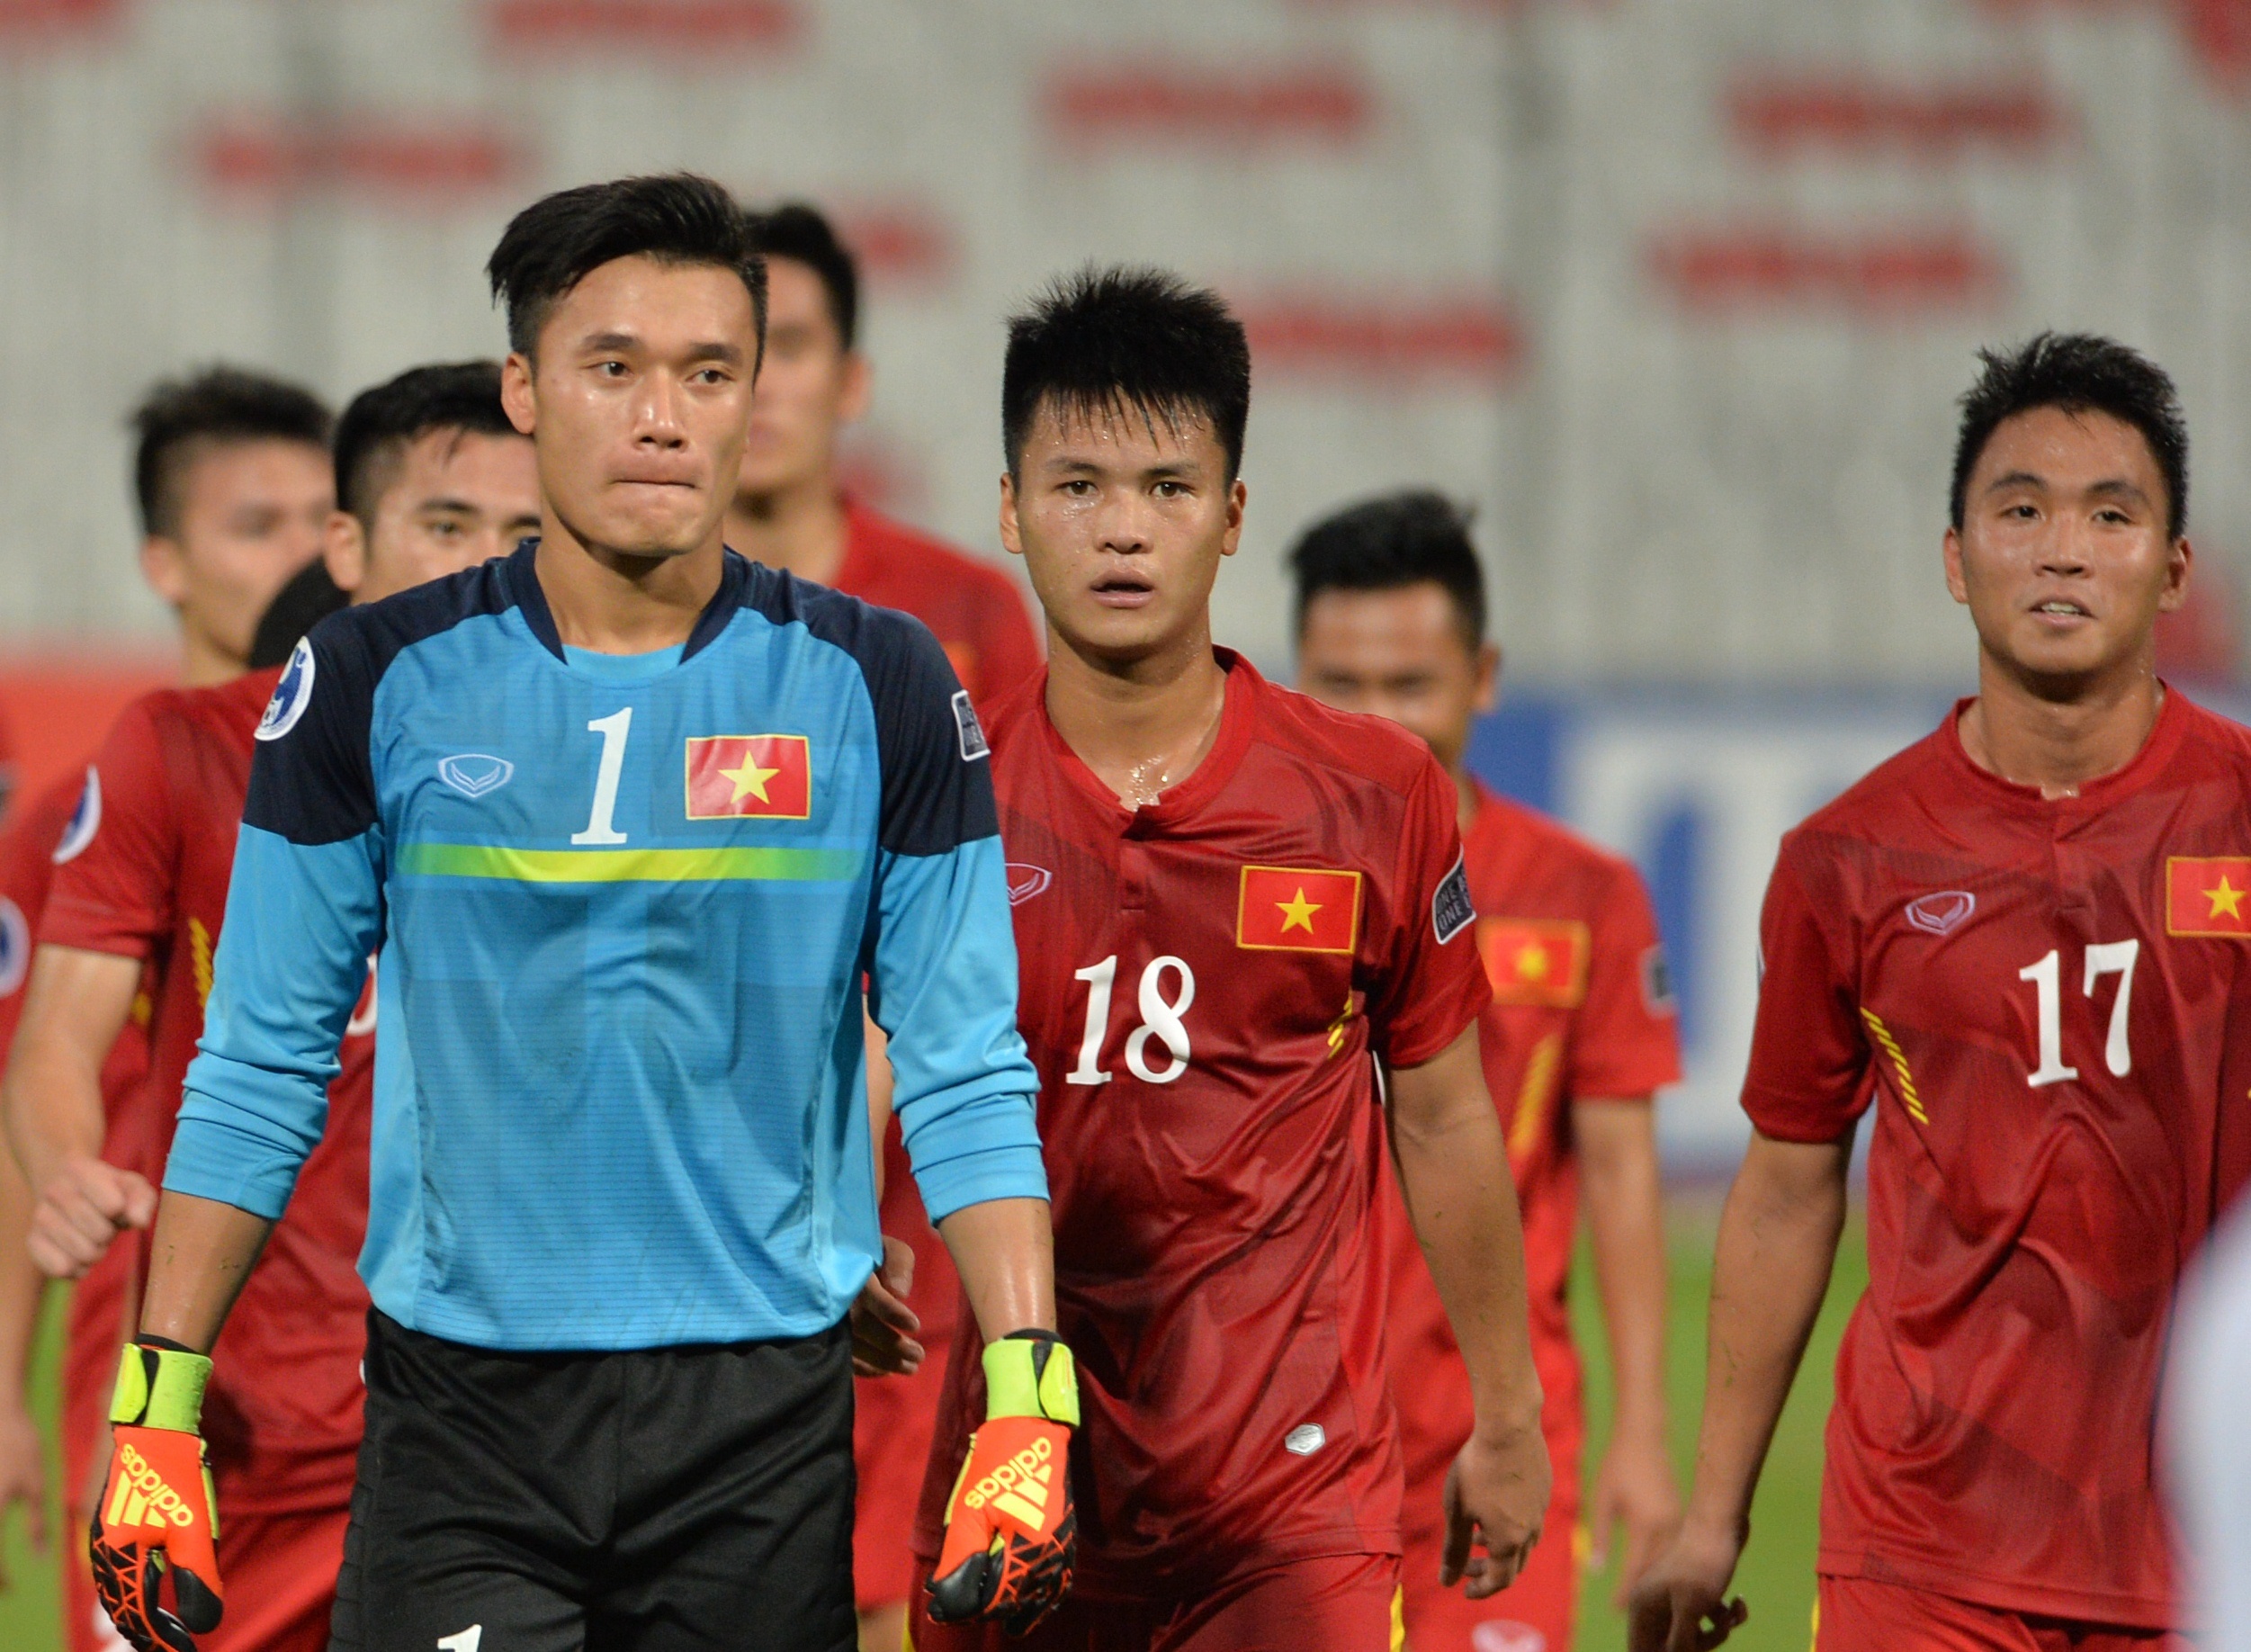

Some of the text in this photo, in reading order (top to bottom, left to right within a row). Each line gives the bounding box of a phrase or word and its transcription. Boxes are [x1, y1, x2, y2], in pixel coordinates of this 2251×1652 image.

[570, 706, 633, 846] 1
[1065, 955, 1196, 1085] 18
[2018, 938, 2140, 1088] 17
[120, 1443, 194, 1527] adidas
[964, 1437, 1052, 1510] adidas
